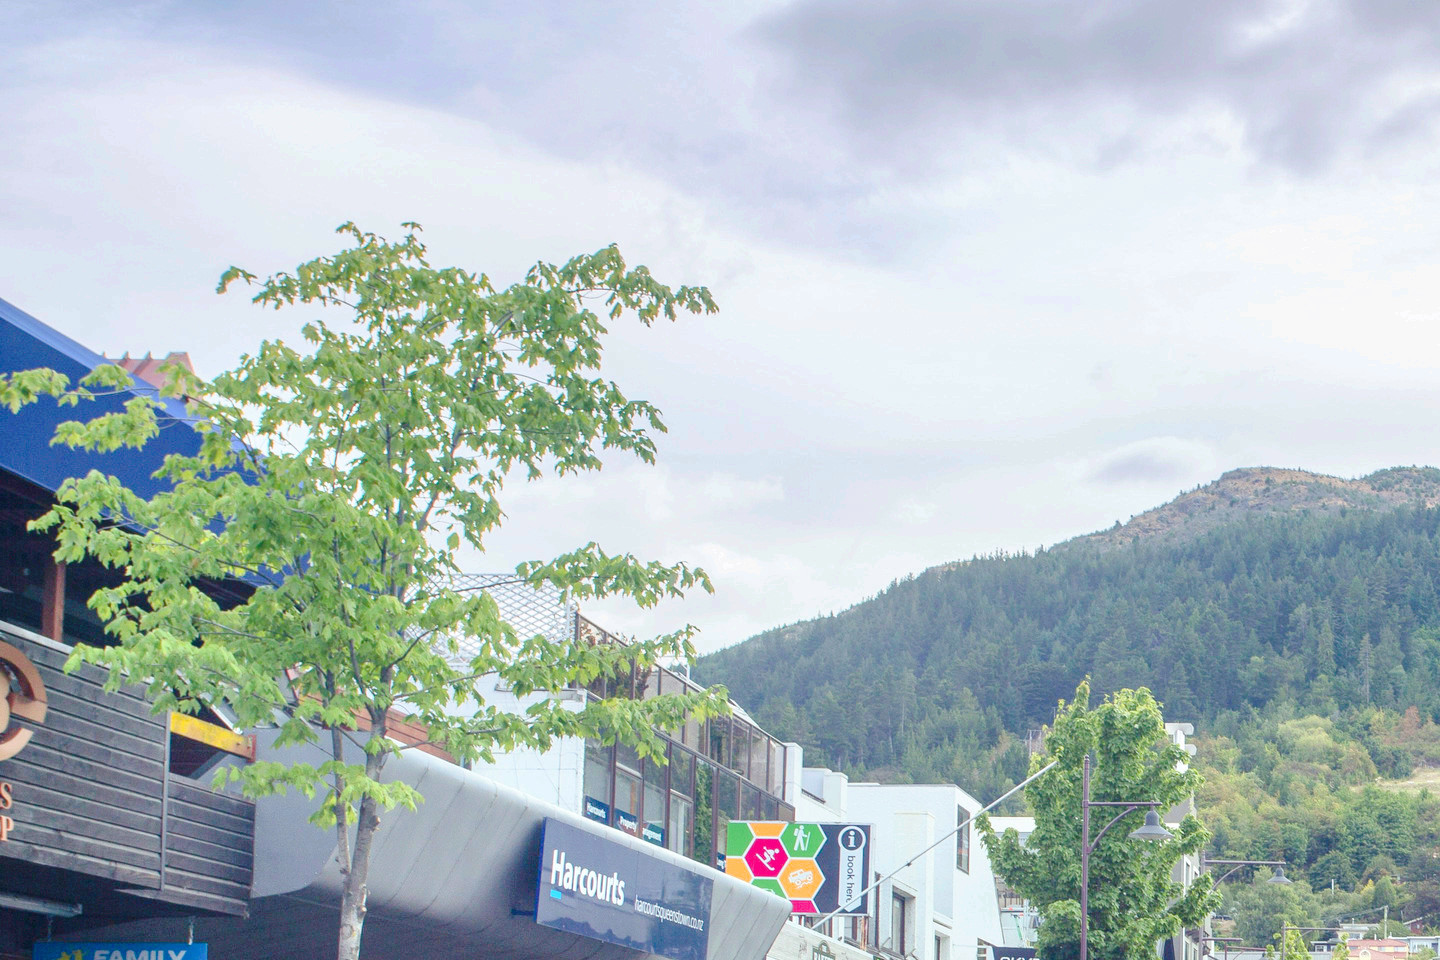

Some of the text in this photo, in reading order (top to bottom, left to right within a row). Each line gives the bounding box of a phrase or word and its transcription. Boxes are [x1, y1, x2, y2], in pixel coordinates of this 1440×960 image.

[550, 849, 626, 906] Harcourts
[847, 855, 856, 880] book
[634, 894, 704, 931] harcourtsqueenstown.co.nz
